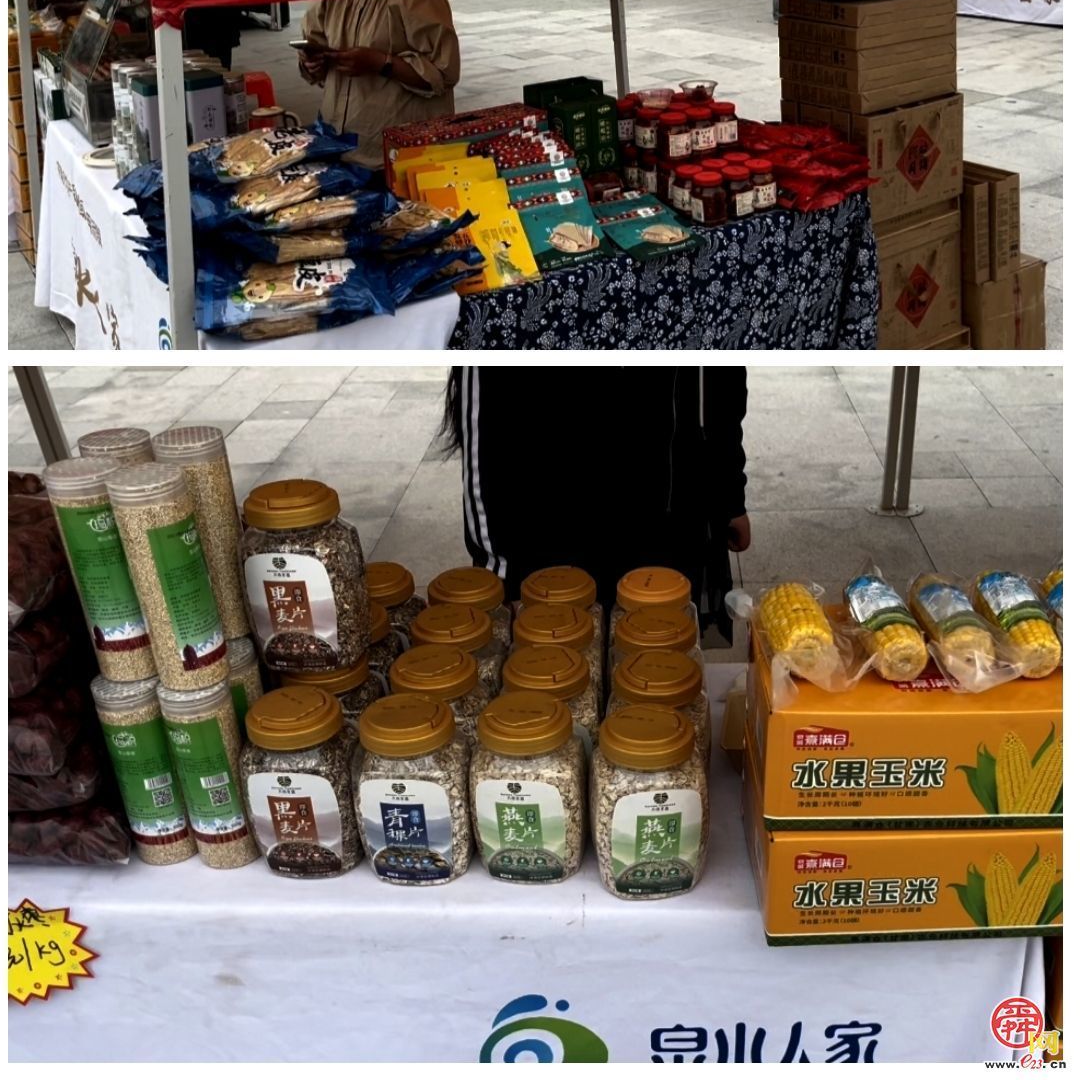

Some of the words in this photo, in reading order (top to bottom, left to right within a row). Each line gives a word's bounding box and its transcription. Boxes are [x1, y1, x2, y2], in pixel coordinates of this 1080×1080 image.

[791, 758, 947, 789] 水果玉米
[793, 877, 939, 908] 水果玉米
[649, 1020, 883, 1062] 泉水人家
